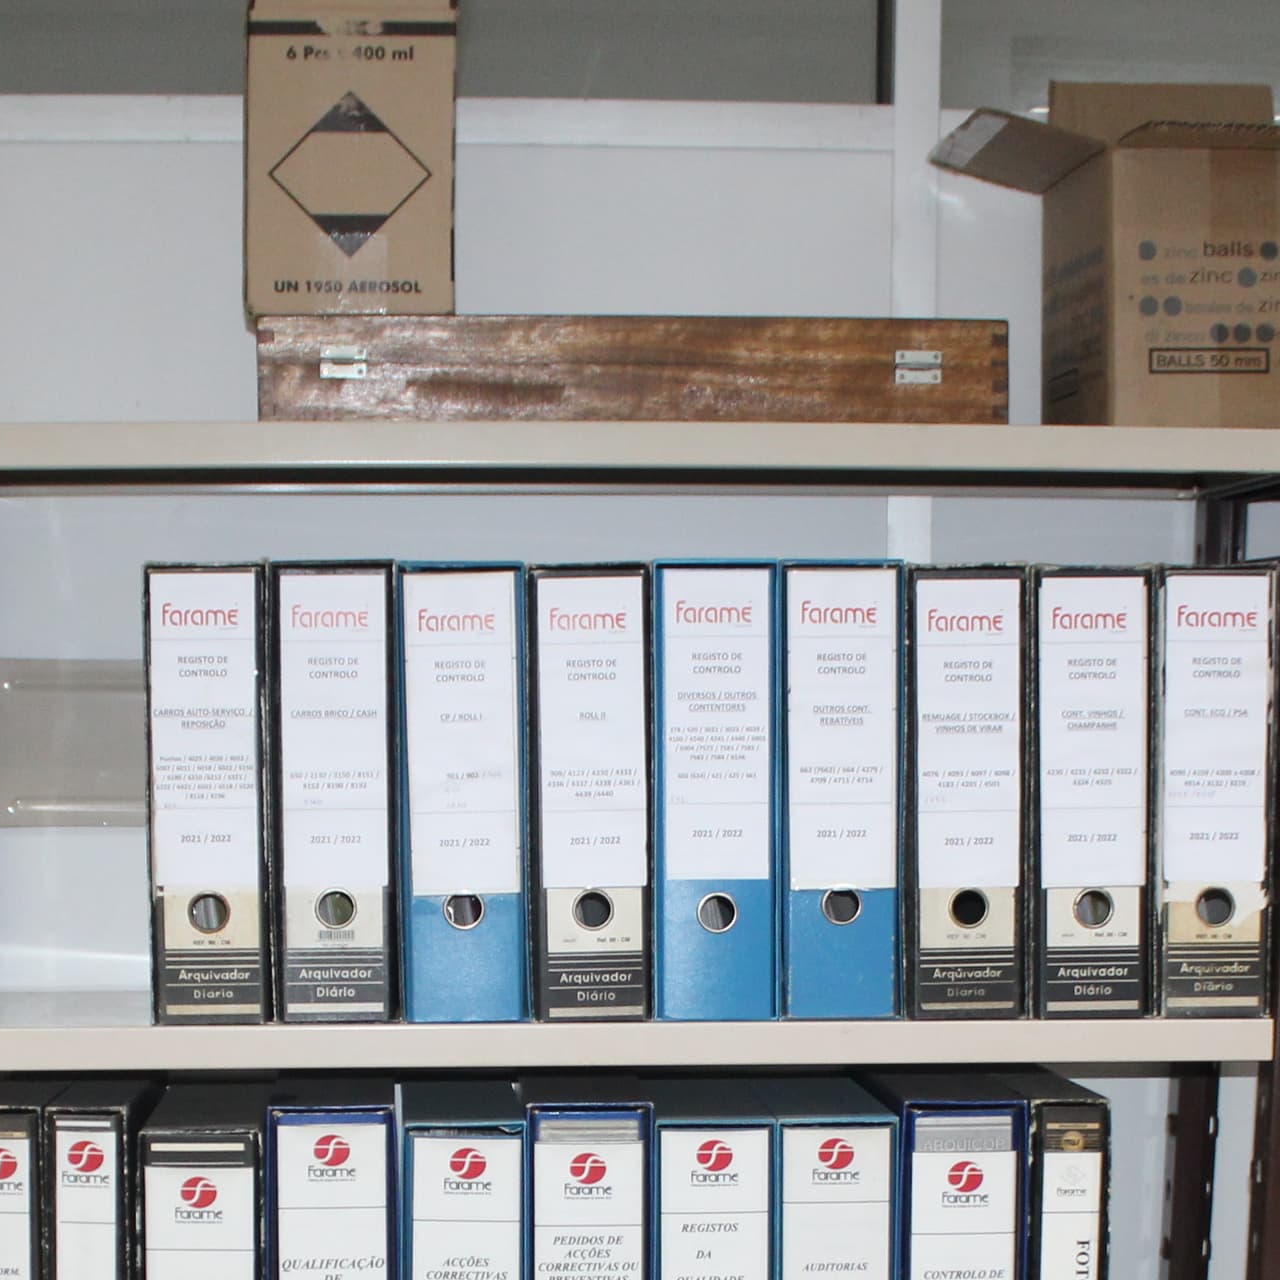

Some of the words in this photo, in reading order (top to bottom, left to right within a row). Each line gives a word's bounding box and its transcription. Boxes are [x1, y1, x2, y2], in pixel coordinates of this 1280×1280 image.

[286, 46, 297, 60] 6
[392, 46, 414, 60] ml
[1203, 240, 1254, 257] balls
[1189, 269, 1233, 283] zinc
[274, 281, 299, 293] UN
[305, 281, 343, 293] 1950
[347, 281, 422, 294] AEROSOL
[1156, 355, 1205, 368] BALLS
[1210, 355, 1230, 368] 50
[1234, 356, 1261, 367] mm
[177, 655, 213, 665] REGISTO
[216, 655, 228, 664] DE
[178, 669, 228, 678] CONTROLO
[677, 691, 715, 701] DIVERSOS
[723, 690, 757, 700] OUTROS
[153, 708, 184, 717] CARROS
[688, 703, 746, 712] CONTENTORES
[812, 704, 846, 714] OUTROS
[290, 709, 322, 719] CARROS
[181, 718, 227, 729] REPOSIÇÃO
[180, 834, 202, 844] 2021
[210, 834, 232, 843] 2022
[178, 969, 251, 982] Arquivador
[299, 967, 373, 980] Arquivador
[559, 971, 633, 985] Arquivador
[316, 985, 356, 998] Diário
[577, 988, 616, 1002] Diário
[681, 1222, 739, 1233] REGISTOS
[552, 1235, 603, 1246] PEDIDOS
[606, 1235, 624, 1245] DE
[696, 1249, 712, 1260] DA
[281, 1257, 385, 1272] QUALIFICAÇÃO
[804, 1262, 868, 1272] AUDITORIAS
[426, 1271, 508, 1280] CORRECTIVAS
